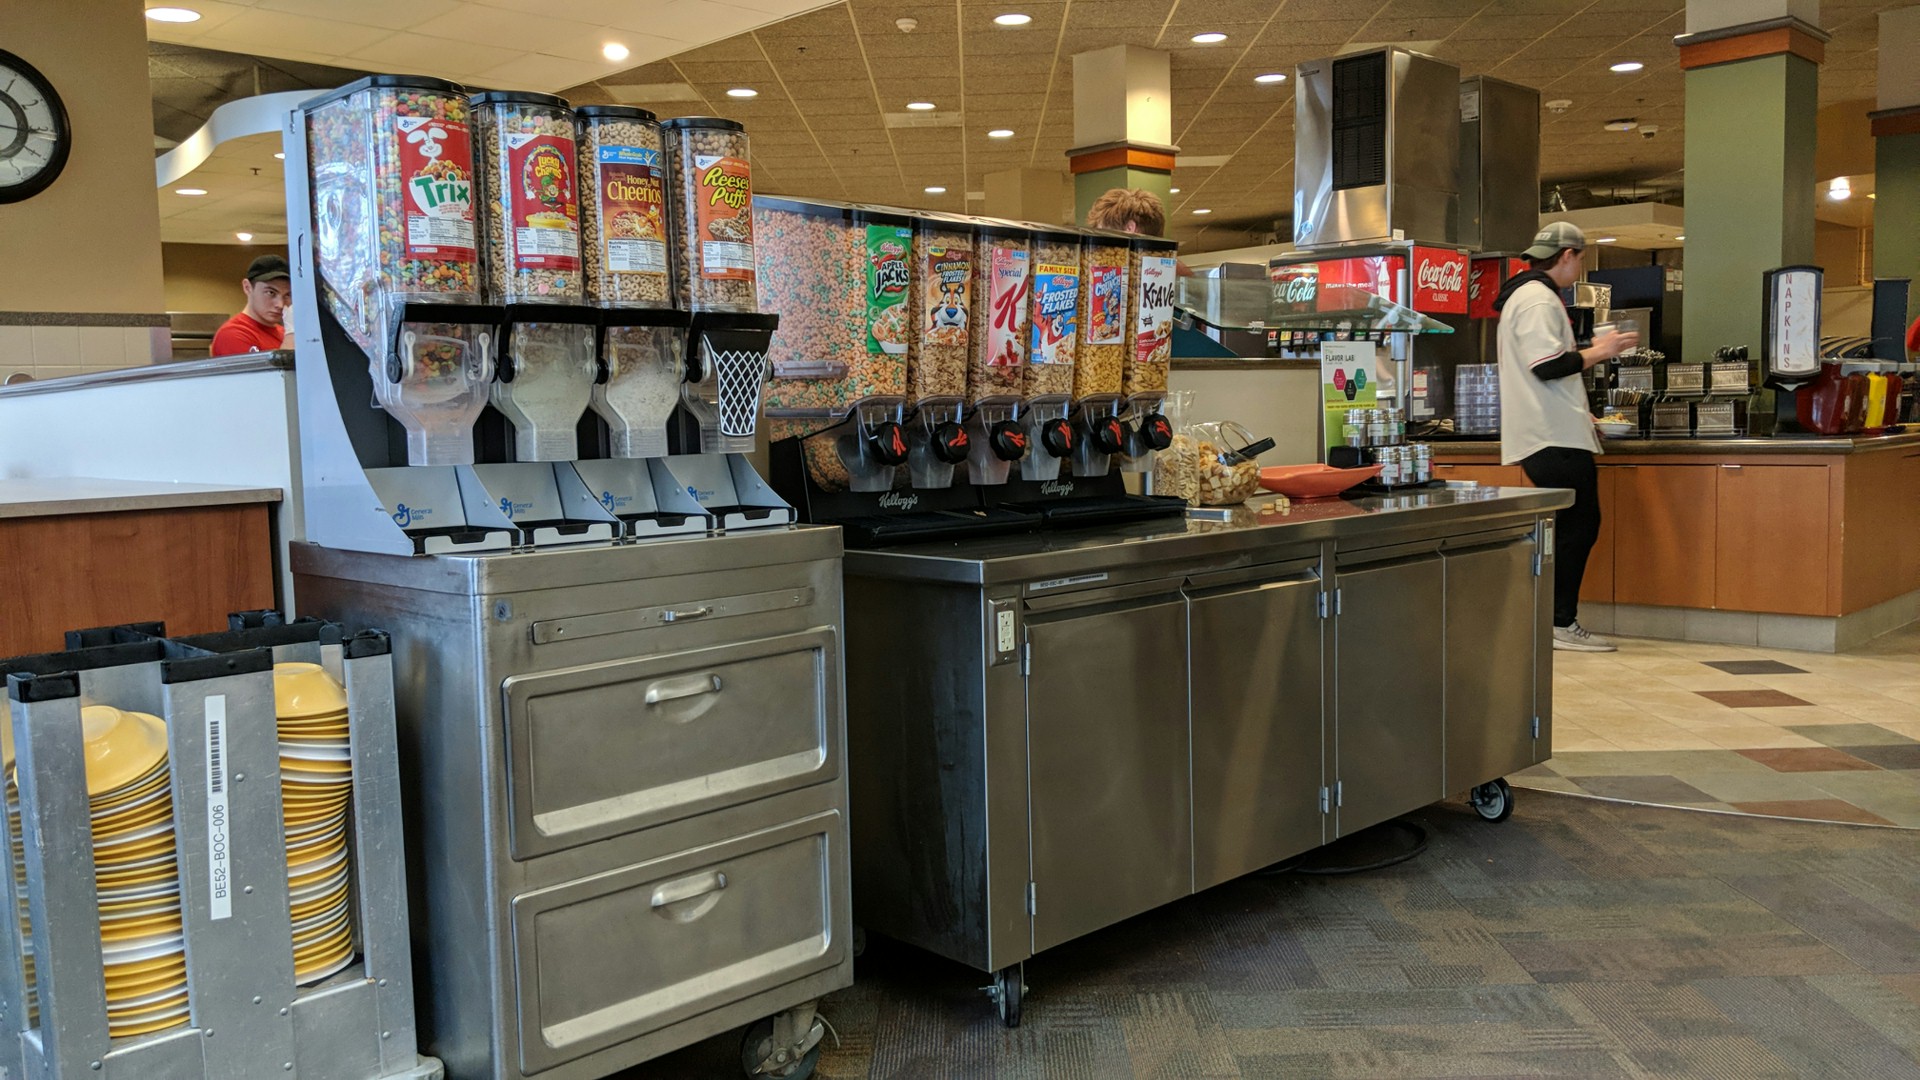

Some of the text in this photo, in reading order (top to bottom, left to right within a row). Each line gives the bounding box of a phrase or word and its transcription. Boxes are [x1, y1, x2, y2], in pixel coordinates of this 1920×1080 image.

[537, 156, 560, 169] Lucky
[534, 166, 562, 179] Charms
[626, 174, 649, 188] Honey
[650, 177, 660, 188] Nut
[703, 167, 749, 190] Reese's
[413, 172, 470, 208] Trix
[607, 181, 662, 204] Cheerios
[710, 186, 747, 209] Puffs
[882, 261, 903, 270] APPLE
[935, 261, 970, 272] CINNAMON
[999, 267, 1023, 278] Special
[1039, 265, 1077, 275] FAMILY SIZE
[875, 269, 909, 294] JACKS
[1418, 258, 1464, 292] Coca-Cola
[994, 274, 1029, 333] K
[1042, 287, 1078, 304] FROSTED
[1041, 299, 1076, 314] FLAKES
[1783, 273, 1793, 369] NAPKINS
[1325, 354, 1355, 362] FLAVOR LAB
[1041, 481, 1075, 496] Kellogg's
[878, 491, 919, 510] Kellogg's
[212, 804, 227, 899] BE52-BOC-006
